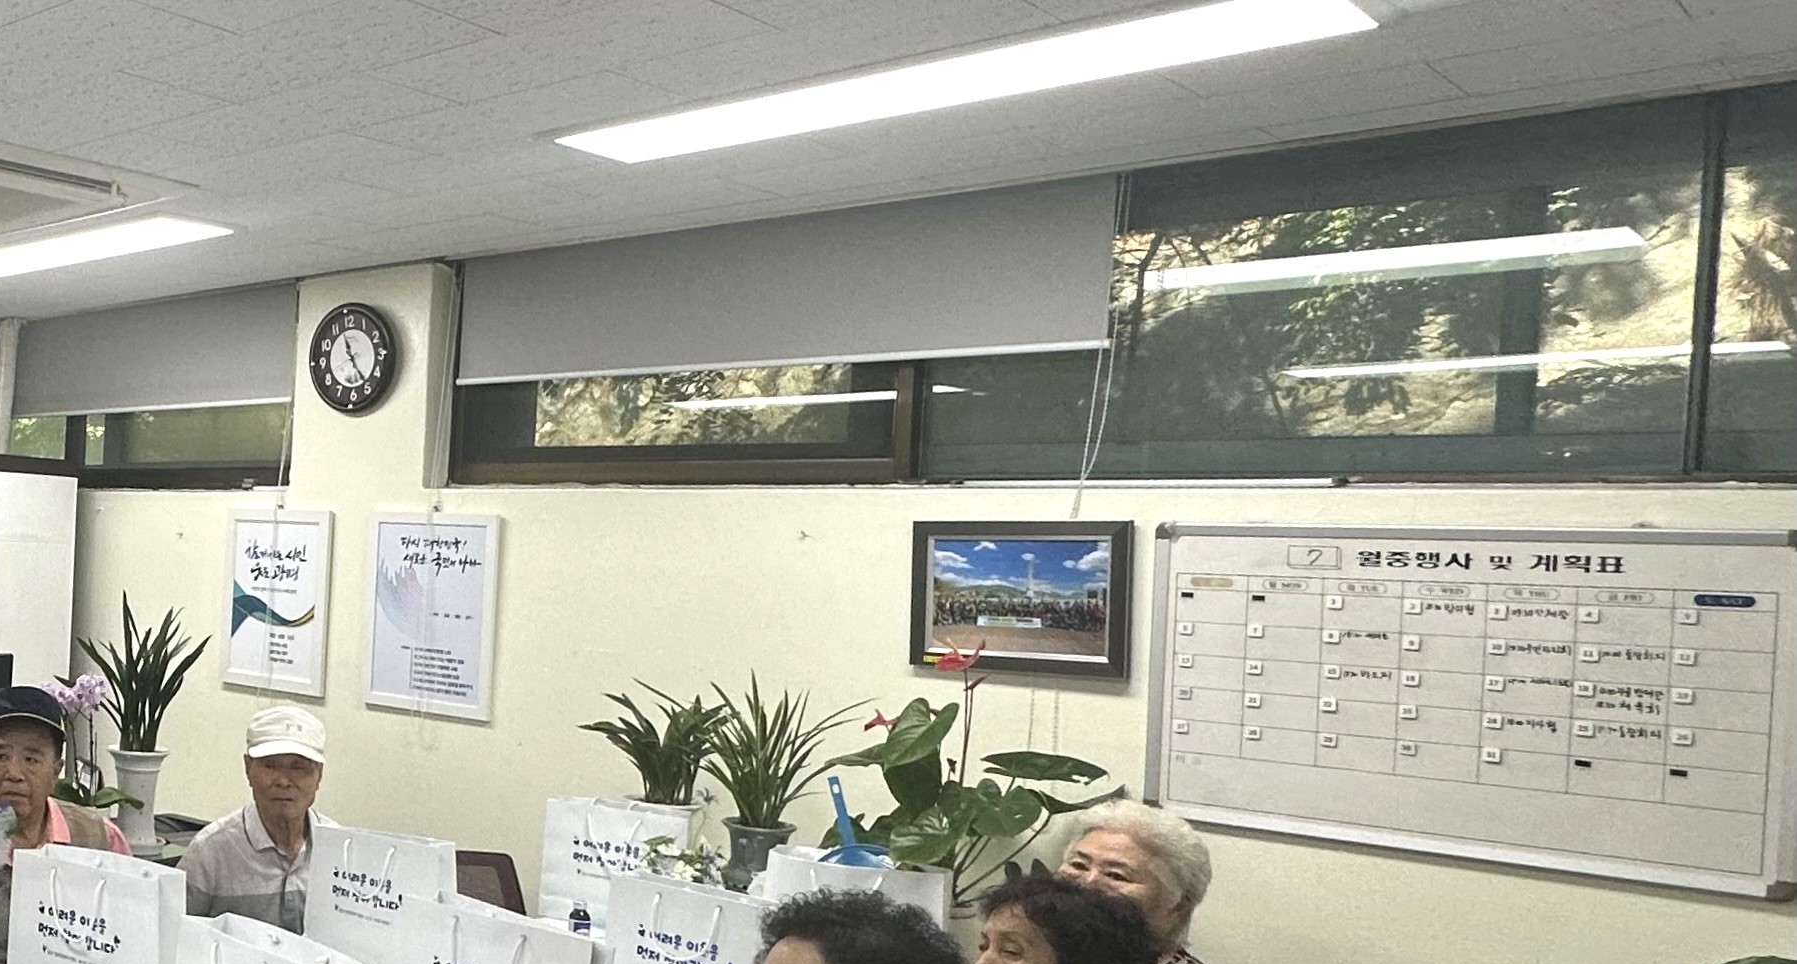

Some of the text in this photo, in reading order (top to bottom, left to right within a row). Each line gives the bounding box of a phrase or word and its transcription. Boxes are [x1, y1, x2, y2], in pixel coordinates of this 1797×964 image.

[345, 316, 355, 328] 12
[362, 318, 366, 330] 1
[332, 322, 340, 336] 11
[372, 331, 380, 343] 2
[321, 338, 332, 352] 10
[378, 348, 385, 360] 3
[320, 357, 326, 369] 9
[374, 366, 380, 378] 4
[325, 373, 332, 386] 8
[336, 385, 342, 397] 7
[350, 388, 357, 400] 6
[364, 382, 372, 394] 5
[400, 536, 420, 549] 다시
[285, 544, 307, 562] 시민
[1357, 550, 1626, 574] 월중행사 및 계획표
[573, 852, 593, 863] 먼저
[332, 885, 350, 897] 먼저
[38, 922, 58, 937] 먼저
[636, 945, 660, 961] 먼저
